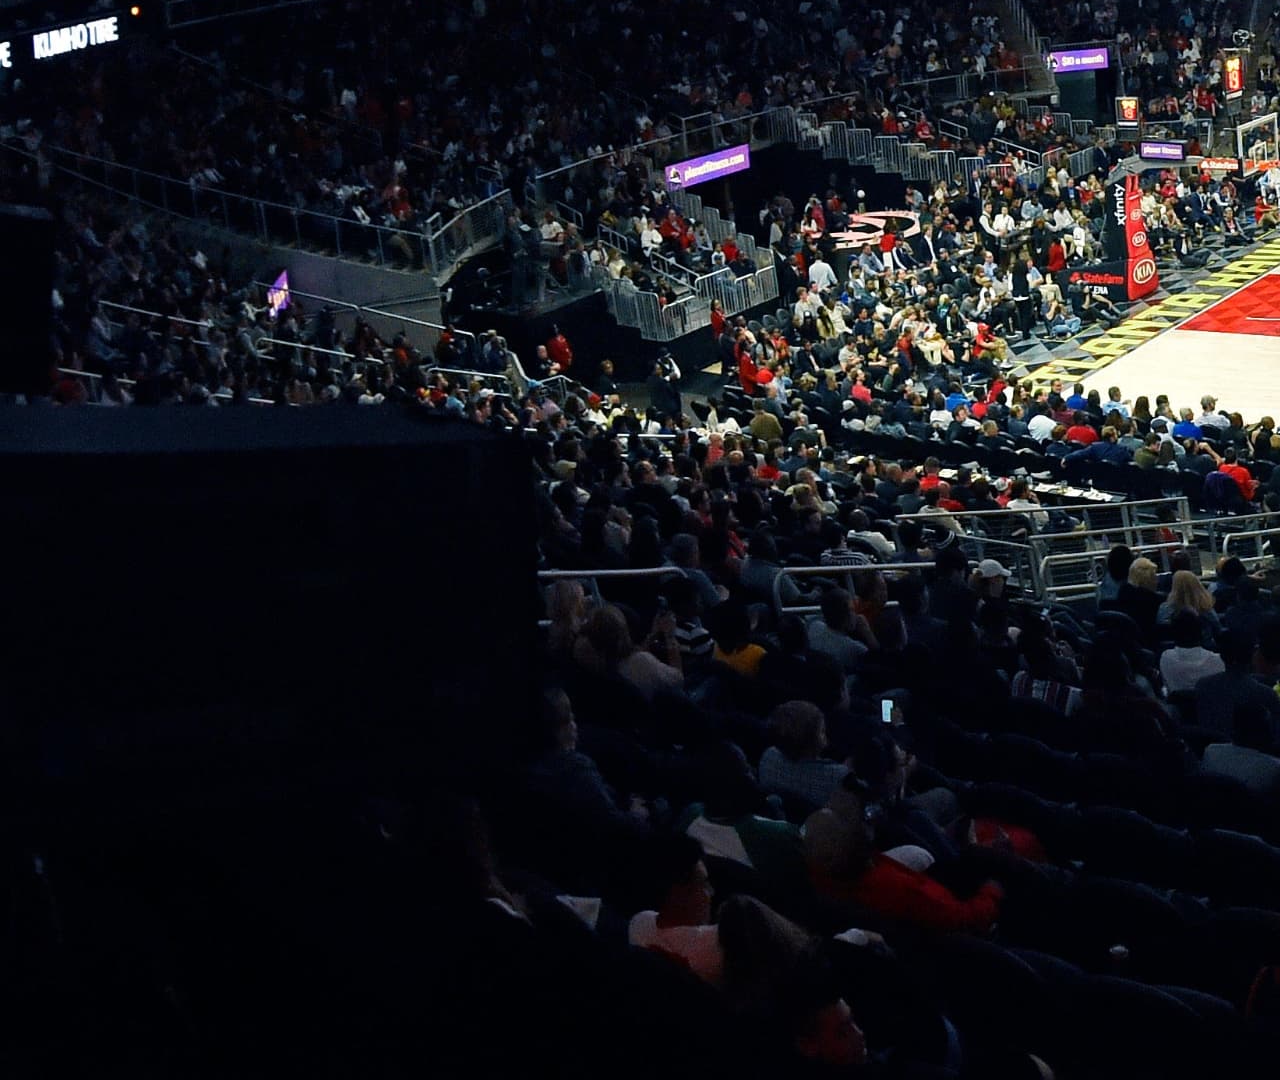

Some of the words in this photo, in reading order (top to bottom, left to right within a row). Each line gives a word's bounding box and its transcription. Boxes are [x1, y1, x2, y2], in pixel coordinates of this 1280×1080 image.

[32, 23, 88, 60] KUMHO
[88, 16, 119, 46] TIRE
[1113, 183, 1127, 226] xfinity
[1136, 263, 1152, 280] KIA
